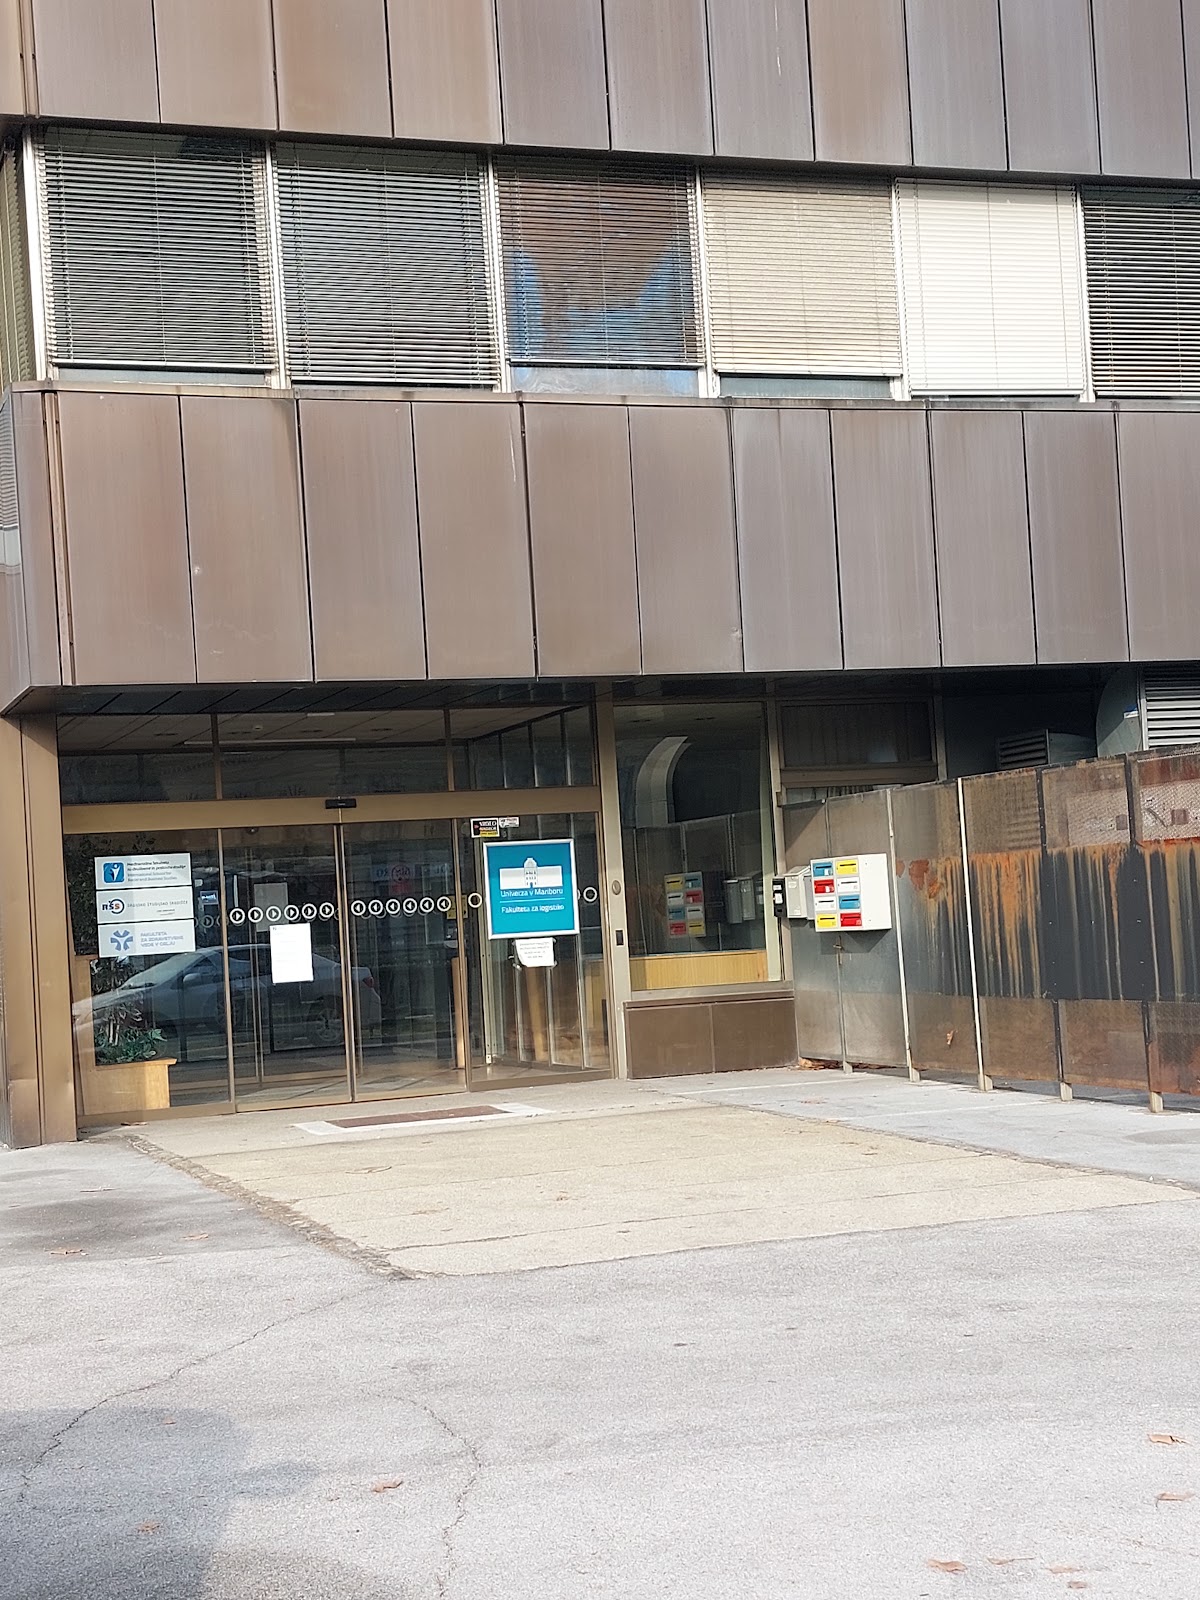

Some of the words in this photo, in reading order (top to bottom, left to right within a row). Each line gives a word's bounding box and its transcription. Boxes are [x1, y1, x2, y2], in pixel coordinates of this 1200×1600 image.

[535, 888, 564, 896] Mariboru
[501, 905, 530, 913] Fakulteta
[540, 904, 565, 913] logistiko
